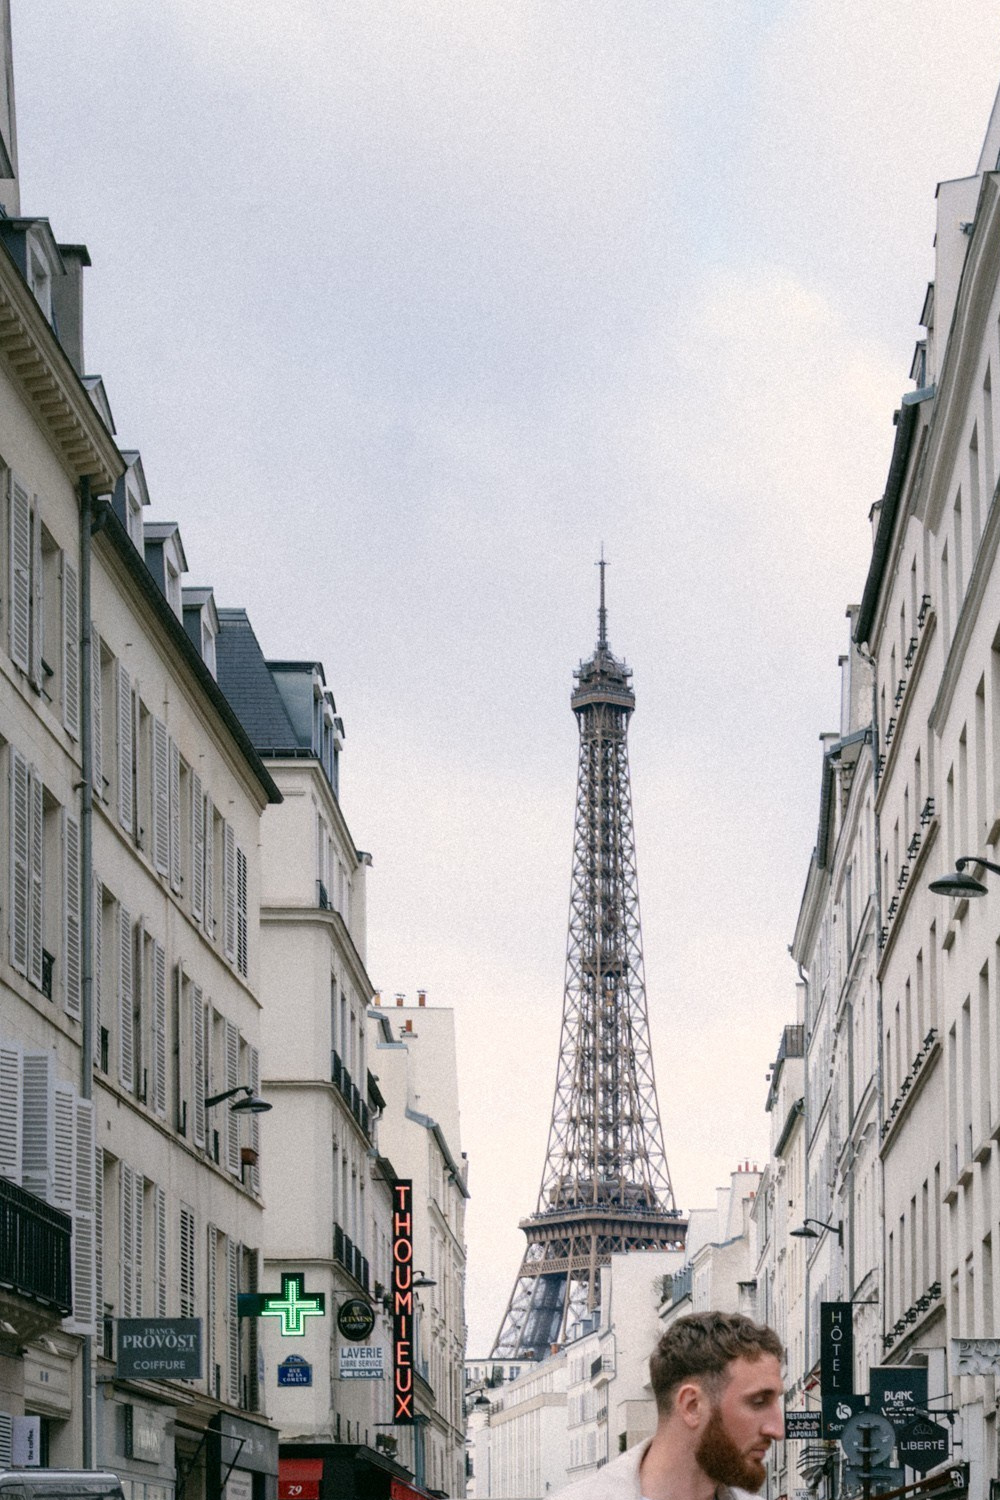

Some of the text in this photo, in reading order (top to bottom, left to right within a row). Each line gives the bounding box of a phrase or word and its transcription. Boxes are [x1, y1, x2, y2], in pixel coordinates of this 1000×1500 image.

[394, 1185, 412, 1419] THOUMIEUX
[122, 1334, 197, 1349] PROVOST
[341, 1347, 382, 1358] LAVERIE
[830, 1311, 843, 1388] HÔTEL
[133, 1360, 186, 1370] COIFFURE
[340, 1360, 382, 1368] LIBRE SERVICE
[884, 1390, 914, 1402] BLANC
[786, 1412, 820, 1420] RESTAURANT
